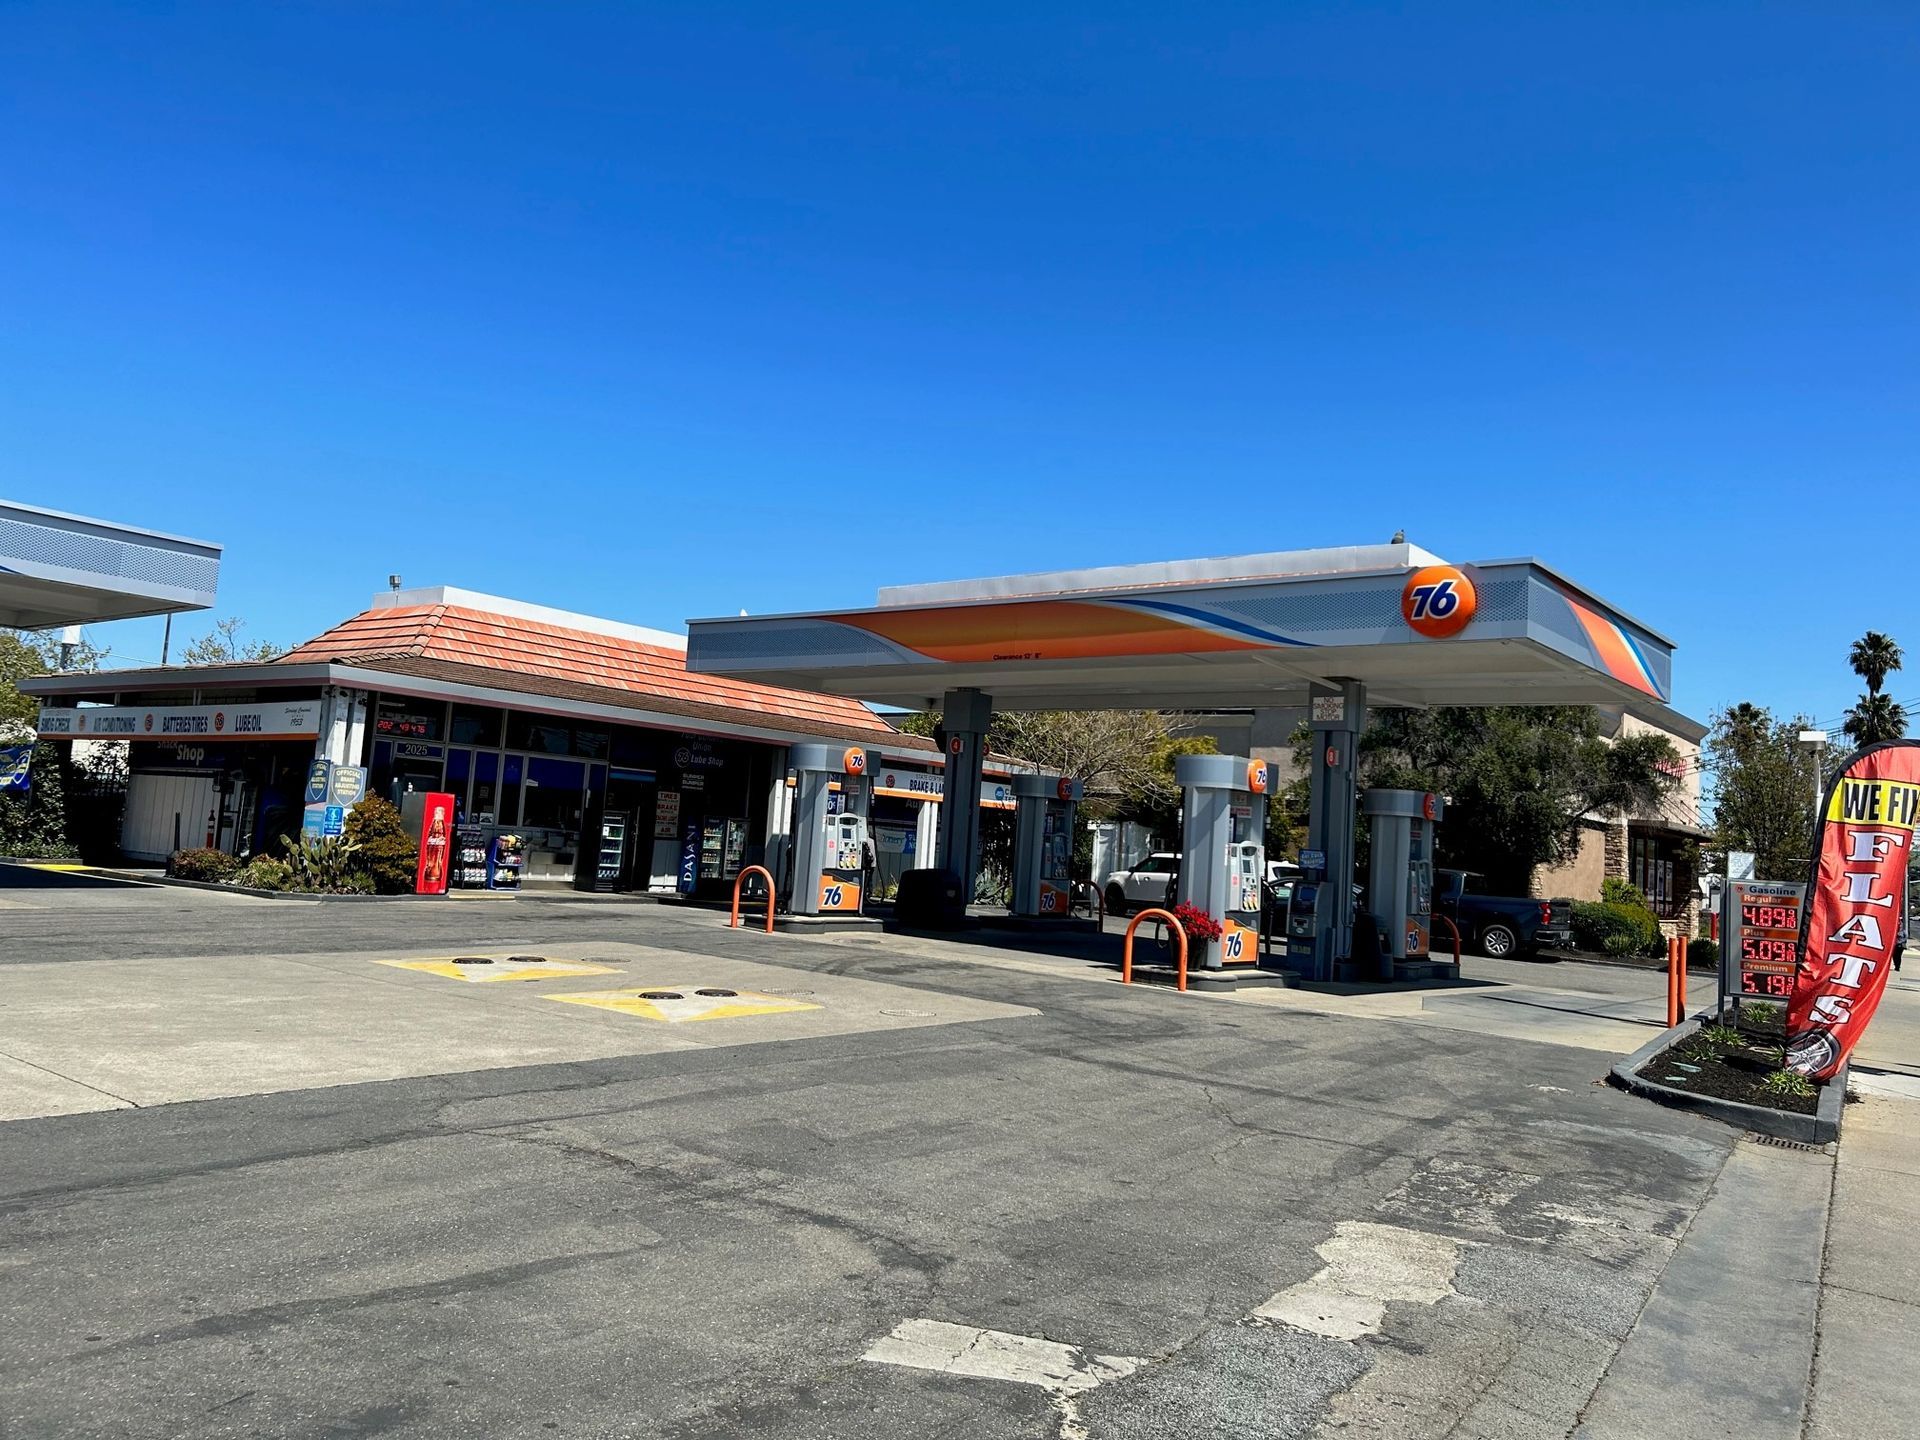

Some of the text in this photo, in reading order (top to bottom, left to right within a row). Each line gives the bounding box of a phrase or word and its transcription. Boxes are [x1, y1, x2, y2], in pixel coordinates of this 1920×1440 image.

[1410, 579, 1459, 620] 76
[163, 716, 208, 733] BATTERIES TIRES
[235, 714, 262, 732] LUBE OIL
[176, 744, 205, 766] Shop
[405, 743, 428, 756] 2025
[690, 754, 707, 764] Lube
[707, 756, 724, 767] Shop
[852, 754, 864, 767] 76
[336, 769, 361, 779] OFFICIAL
[1255, 768, 1267, 785] 76
[909, 780, 929, 793] BRAKE
[1063, 782, 1073, 794] 76
[1844, 783, 1880, 822] WE
[684, 825, 696, 882] DASANI
[822, 884, 843, 907] 76
[1743, 894, 1781, 904] Regular
[1749, 885, 1796, 896] Gasoline
[1041, 891, 1056, 911] 76
[1743, 906, 1786, 928] 4.89
[1743, 928, 1765, 937] Plus
[1808, 830, 1905, 1025] FLATS
[1225, 931, 1243, 958] 76
[1406, 930, 1419, 953] 76
[1743, 939, 1786, 962] 5.09
[1743, 962, 1788, 973] Premium
[1742, 973, 1785, 996] 5.19
